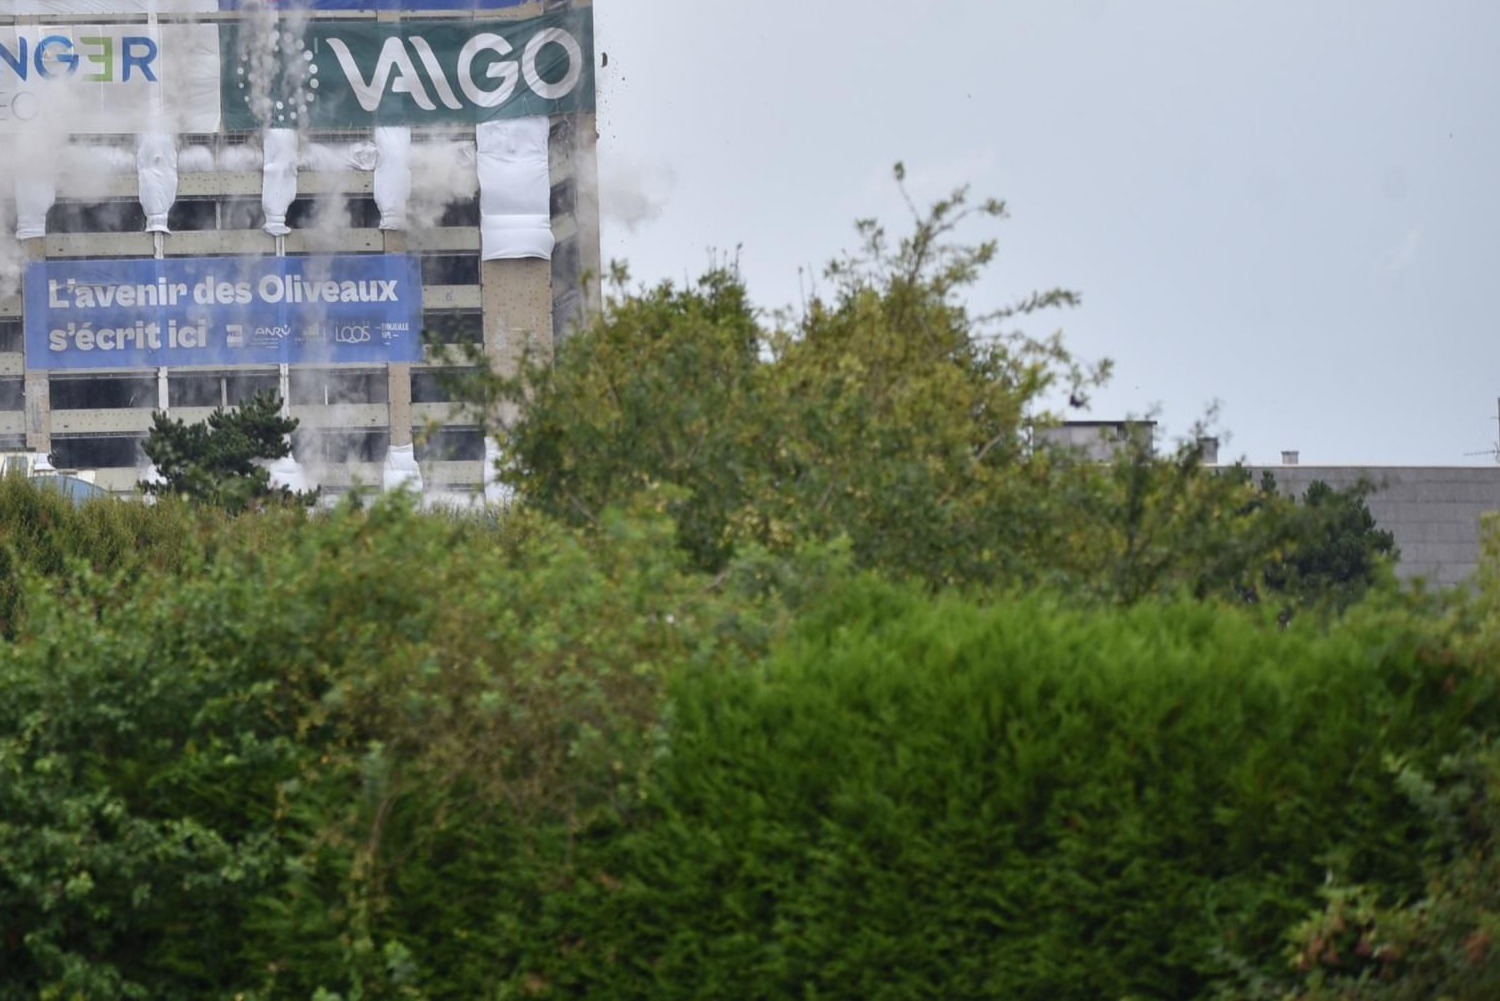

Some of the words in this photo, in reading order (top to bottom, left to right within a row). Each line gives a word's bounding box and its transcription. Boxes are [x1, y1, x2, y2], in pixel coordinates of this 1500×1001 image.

[48, 277, 188, 309] L'avenir
[193, 276, 253, 305] des
[258, 274, 399, 303] Oliveaux
[49, 320, 162, 352] s'écrit
[167, 318, 206, 349] ici
[335, 325, 371, 344] LOOS
